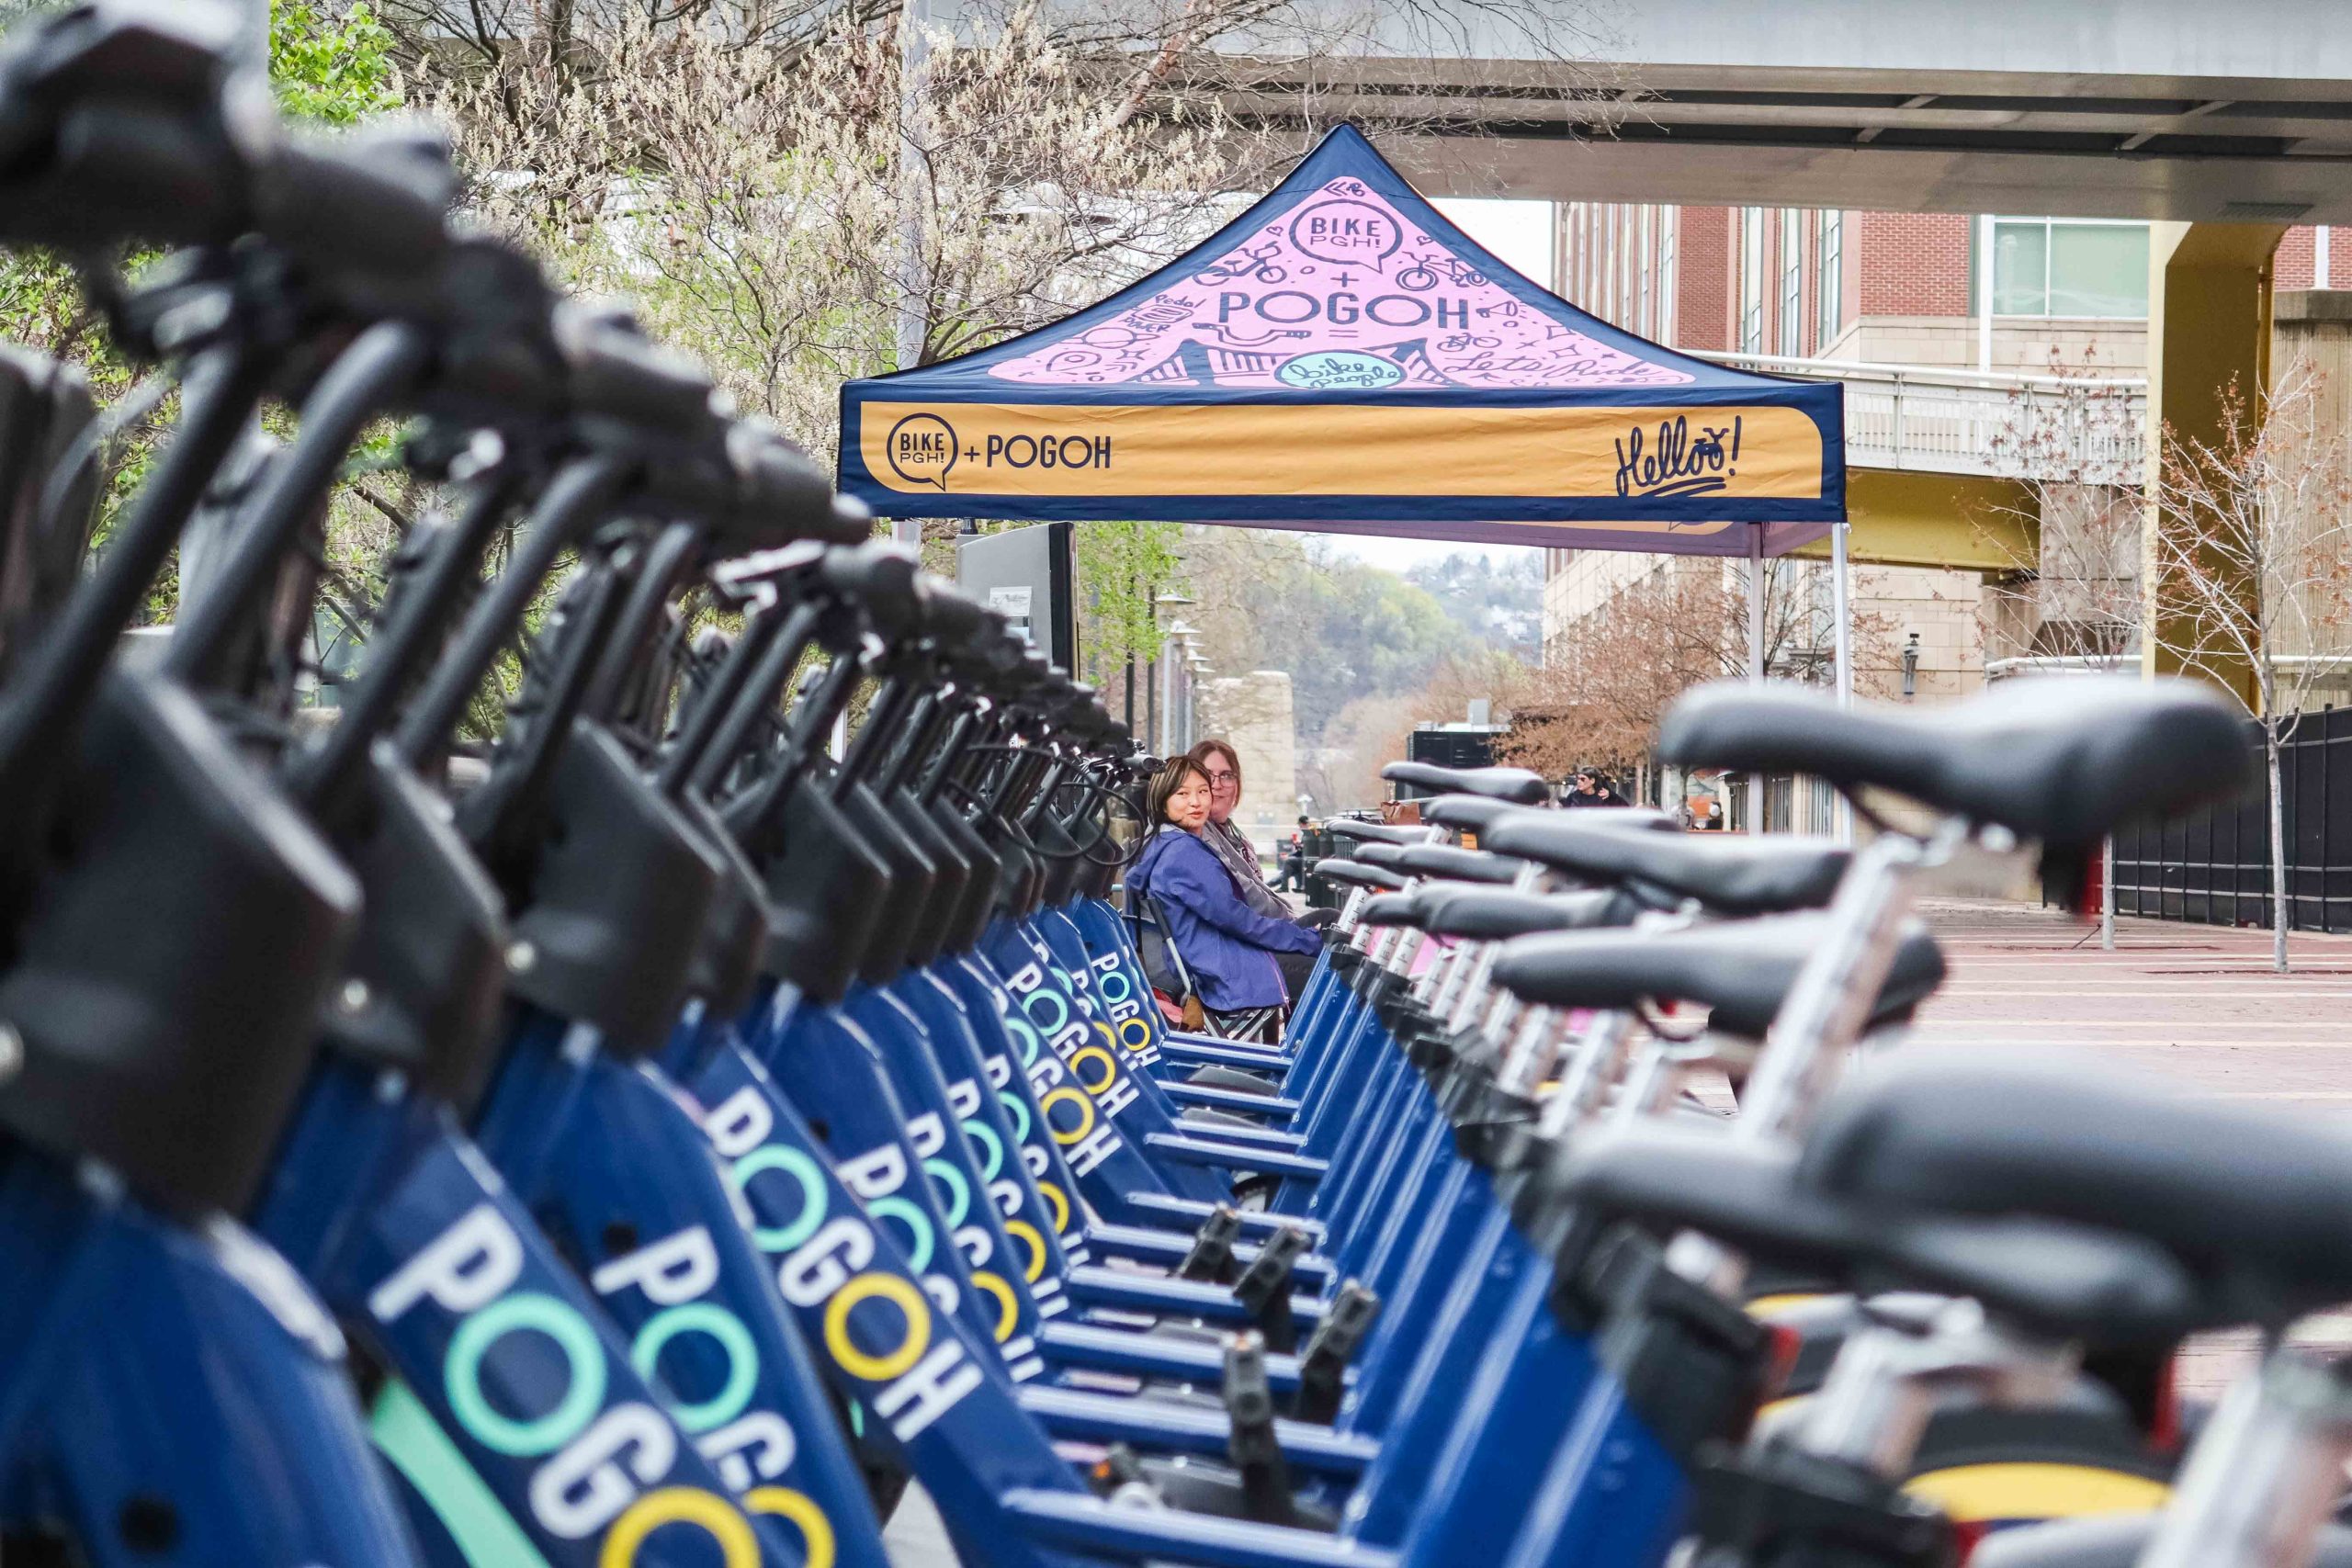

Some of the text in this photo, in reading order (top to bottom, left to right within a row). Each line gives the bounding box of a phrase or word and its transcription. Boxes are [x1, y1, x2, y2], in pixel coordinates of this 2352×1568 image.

[1311, 217, 1381, 238] BIKE
[1310, 235, 1381, 249] PGH!
[1155, 294, 1207, 309] Pedal
[1218, 290, 1470, 330] POGOH
[1288, 357, 1364, 379] bike
[1309, 366, 1398, 389] people
[899, 433, 945, 452] BIKE
[987, 434, 1112, 469] POGOH
[899, 451, 945, 464] PGH!
[1091, 951, 1162, 1068] POGOH
[1005, 961, 1140, 1120] POGOH
